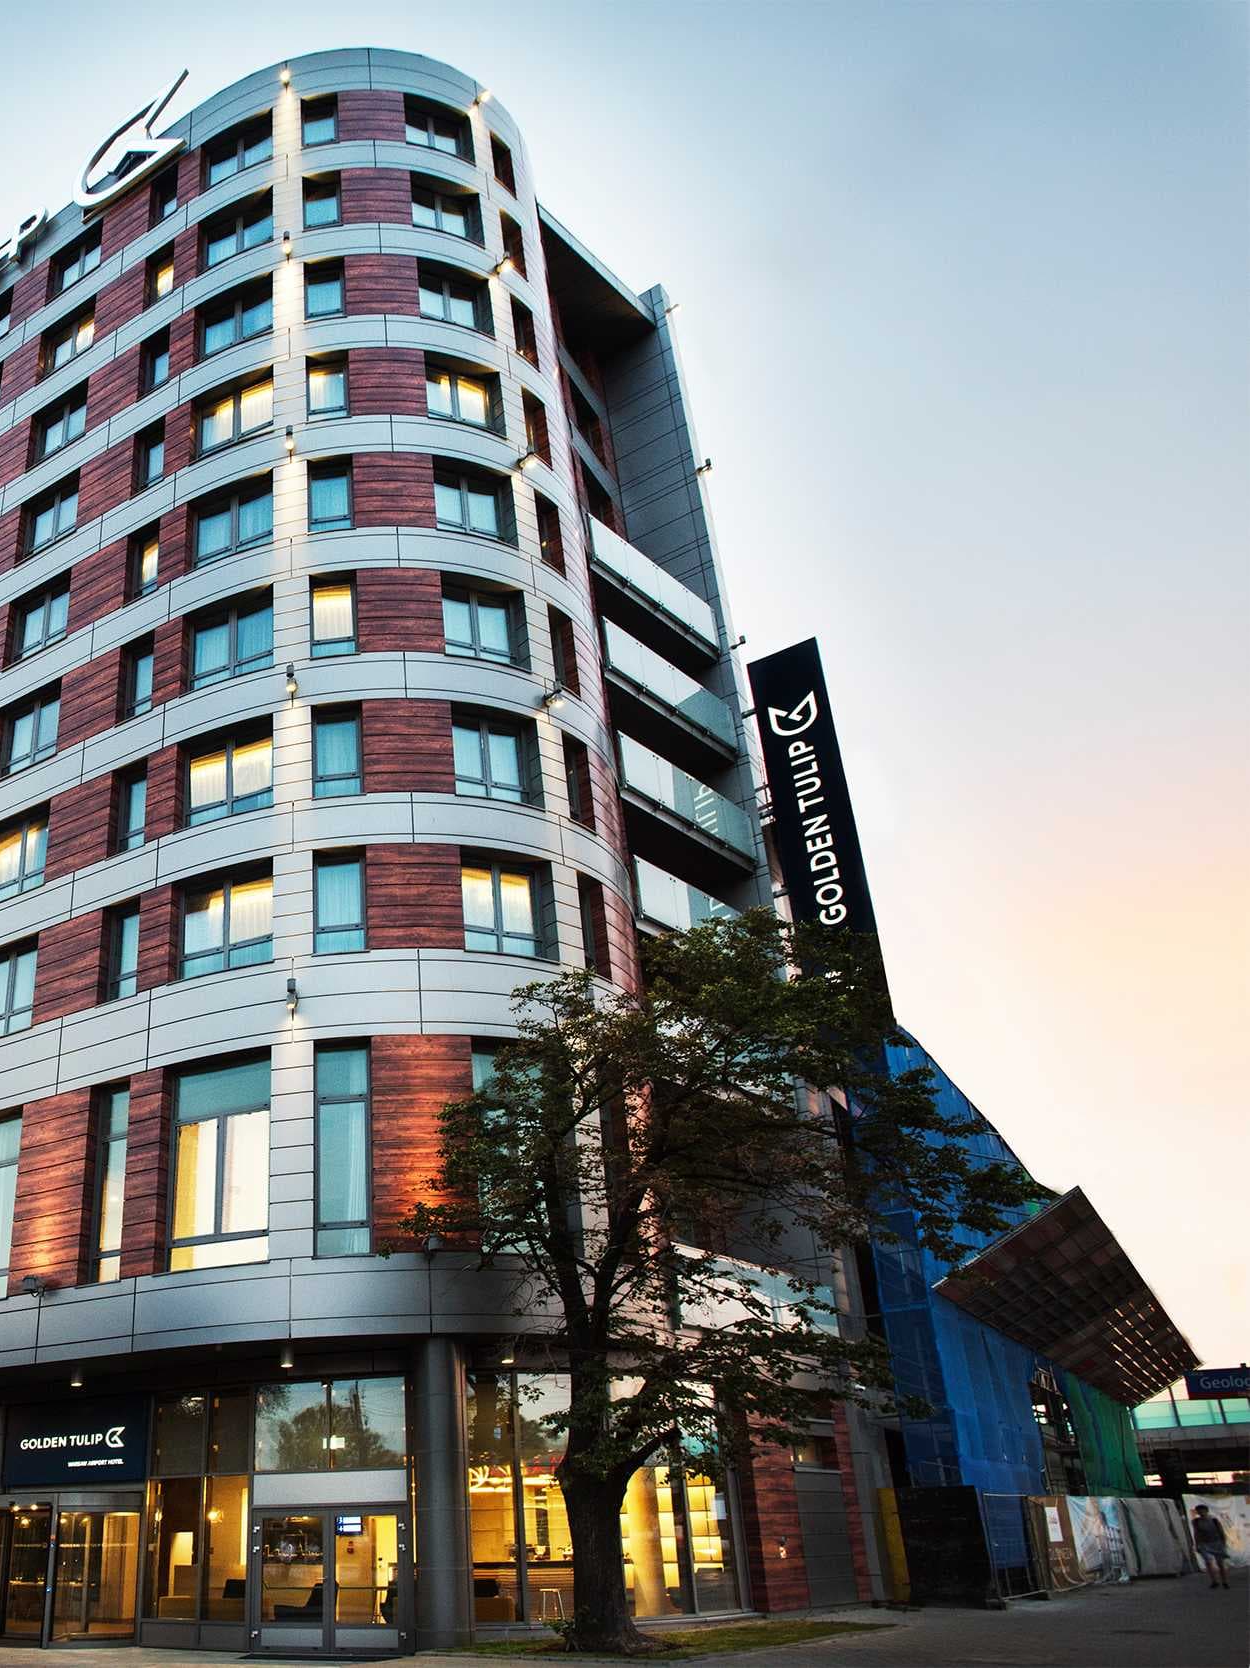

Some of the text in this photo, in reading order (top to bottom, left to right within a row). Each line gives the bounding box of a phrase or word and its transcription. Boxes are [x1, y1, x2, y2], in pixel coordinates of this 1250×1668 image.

[788, 740, 825, 814] TULIP
[802, 813, 848, 926] GOLDEN
[20, 1433, 103, 1449] GOLDEN TULIP
